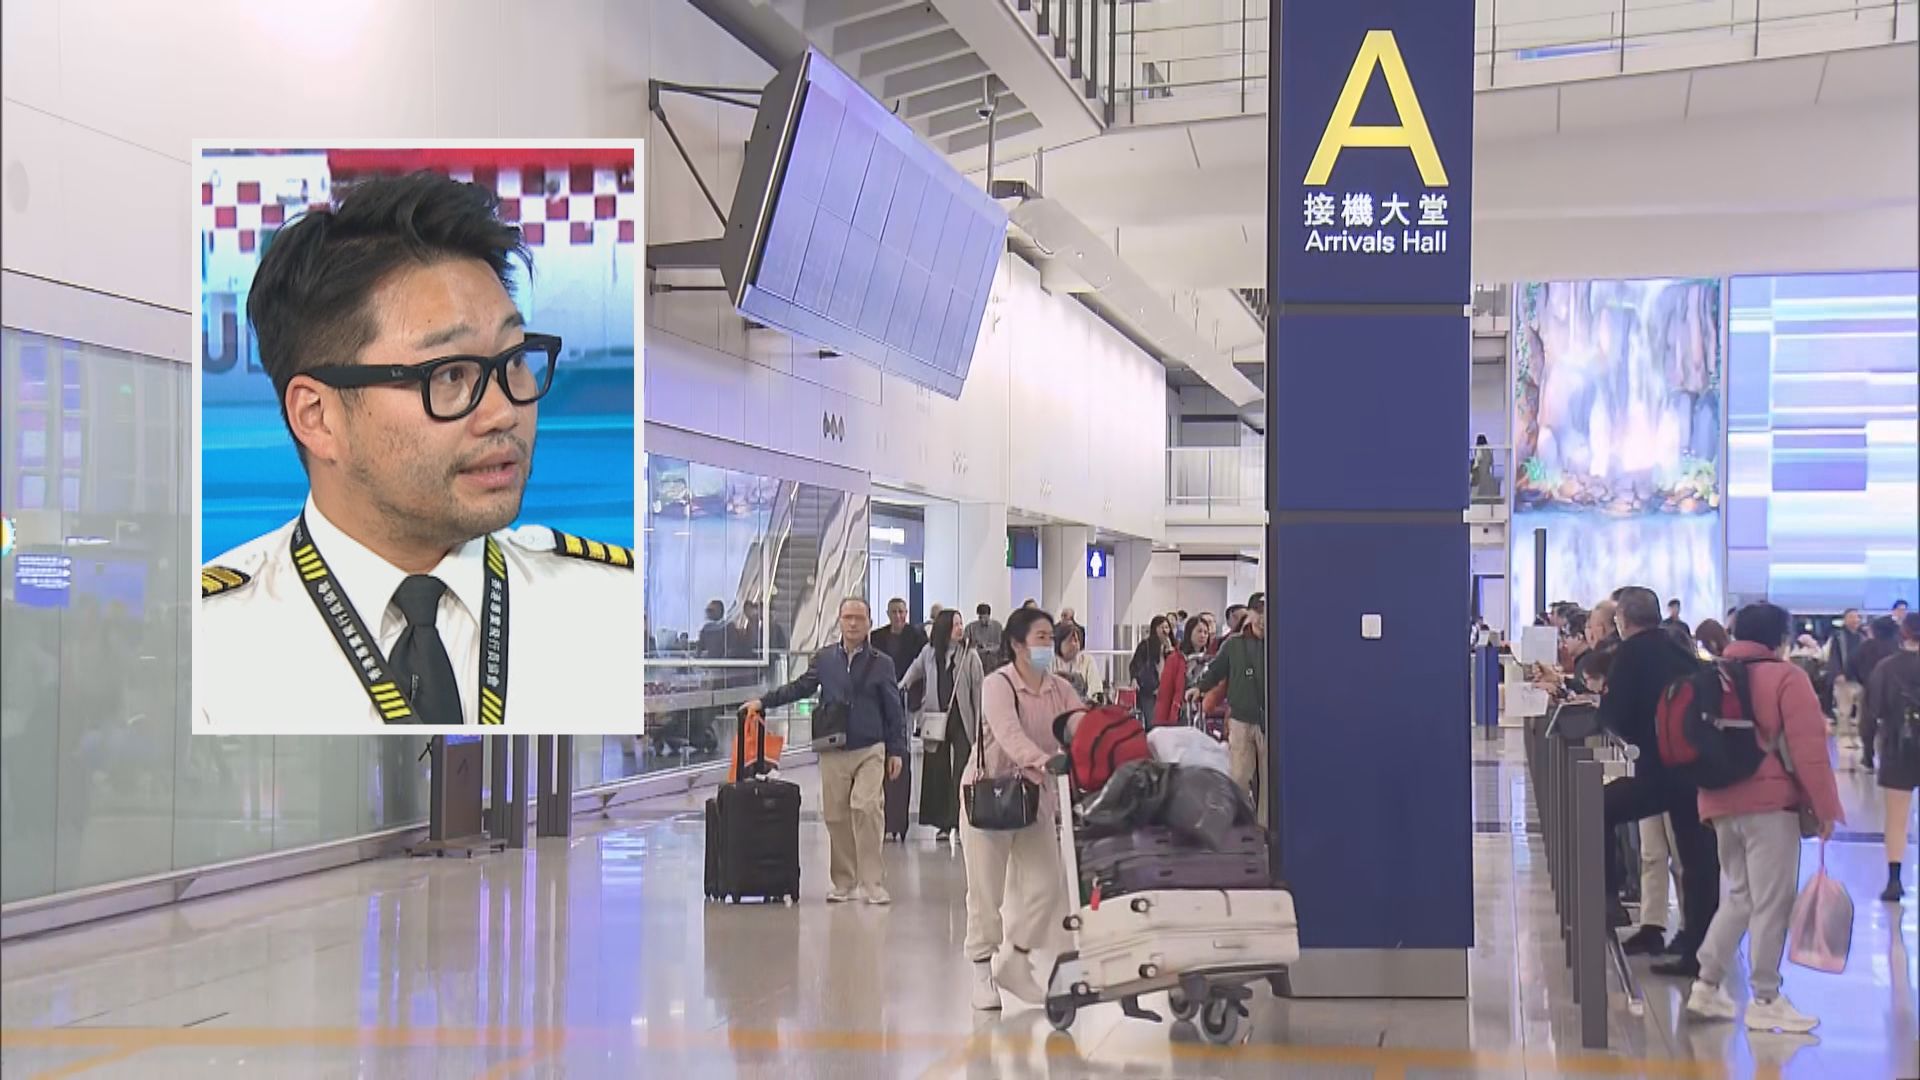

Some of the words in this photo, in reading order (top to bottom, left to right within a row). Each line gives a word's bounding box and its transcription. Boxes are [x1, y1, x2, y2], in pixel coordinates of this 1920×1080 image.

[1303, 29, 1449, 187] A
[1303, 192, 1449, 227] 接機大堂
[1304, 230, 1395, 253] Arrivals
[1402, 230, 1447, 253] Hall
